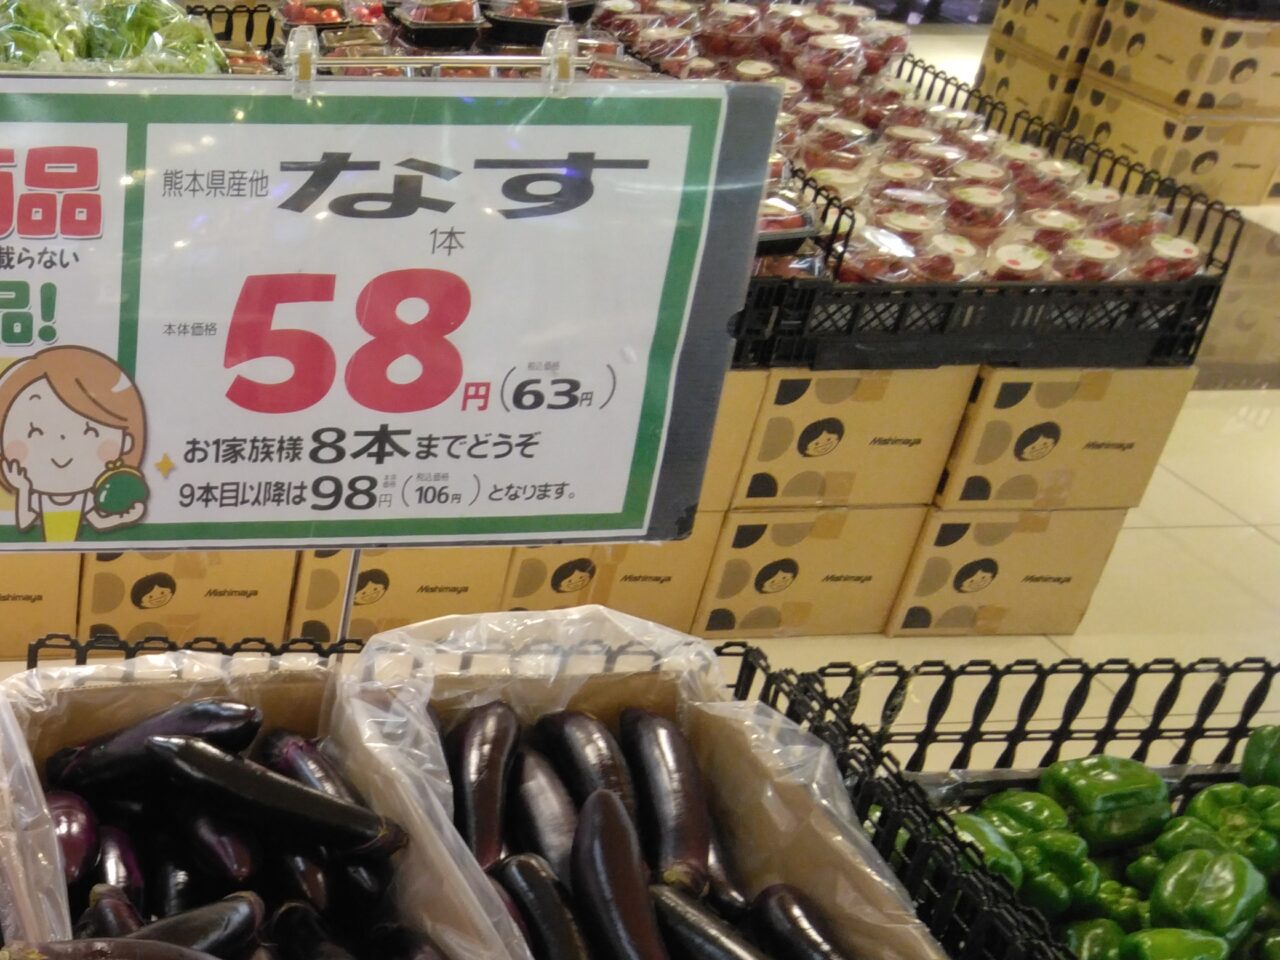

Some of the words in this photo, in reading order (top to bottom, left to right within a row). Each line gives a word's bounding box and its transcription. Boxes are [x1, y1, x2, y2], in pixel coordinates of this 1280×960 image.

[162, 169, 269, 198] 熊本県産他
[278, 151, 649, 219] なす
[429, 225, 465, 257] 1本
[162, 322, 218, 337] 本体価格
[204, 588, 259, 599] Mishimaya
[416, 584, 469, 596] Mishimaya
